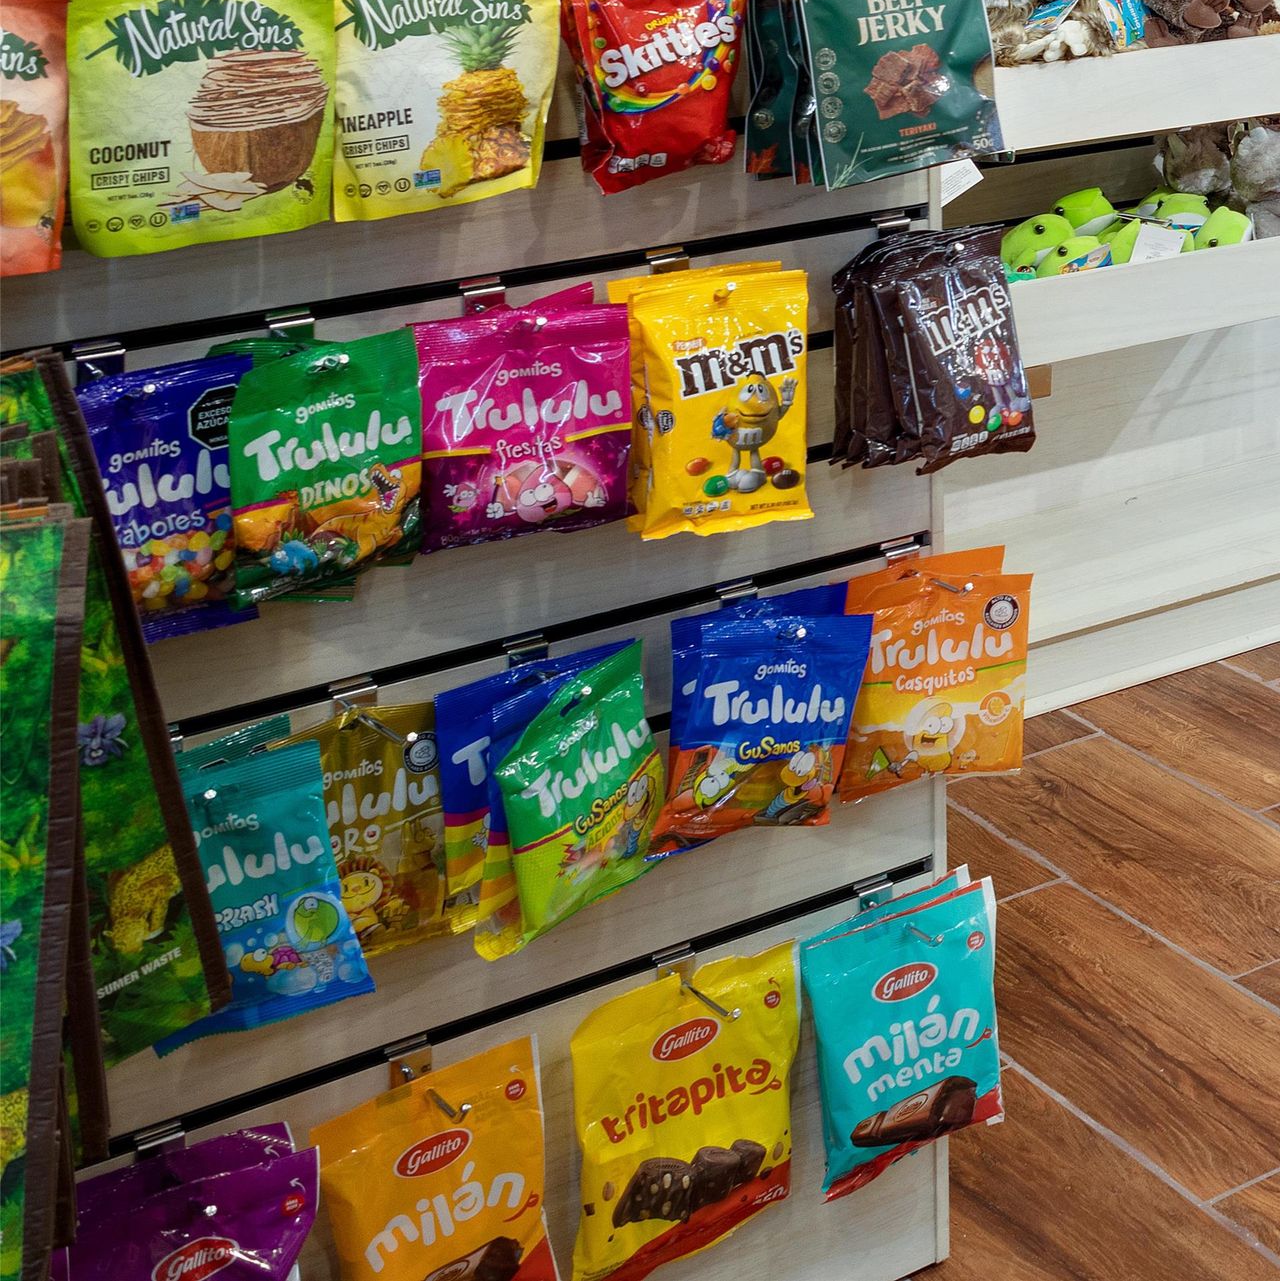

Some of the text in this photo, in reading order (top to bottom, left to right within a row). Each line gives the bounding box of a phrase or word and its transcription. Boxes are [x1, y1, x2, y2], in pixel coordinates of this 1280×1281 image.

[856, 5, 946, 46] JERKY
[122, 8, 239, 79] Natural
[600, 15, 736, 88] Skittles
[0, 50, 38, 75] ins
[342, 108, 413, 134] INEAPPLE
[898, 123, 937, 137] TERIYAKI
[89, 140, 171, 165] COCONUT
[344, 138, 406, 155] CRISPY CHIPS
[96, 170, 165, 186] CRISPY CHIPS
[496, 359, 563, 386] gomitas
[674, 329, 804, 400] m&m's
[198, 406, 232, 420] EXCESO
[294, 391, 356, 424] gomitas
[436, 382, 622, 431] Trululu
[109, 437, 181, 473] gomitas
[244, 410, 412, 481] Trululu
[496, 433, 562, 465] fresitas
[301, 472, 372, 509] DINOS
[911, 608, 965, 637] gomitas
[869, 623, 1013, 675] Trululu
[754, 658, 807, 681] gomitas
[894, 665, 975, 696] Casquitos
[704, 681, 846, 727] Trululu
[739, 735, 801, 762] GuSanos
[521, 718, 650, 818] Trululu
[135, 946, 182, 978] WASTE
[880, 968, 931, 1001] Gallito
[657, 1025, 713, 1060] Gallito
[842, 994, 981, 1086] milán
[866, 1046, 963, 1103] menta
[599, 1056, 774, 1144] tritapita
[405, 1133, 462, 1175] Gallito
[364, 1161, 526, 1274] milán
[166, 1246, 226, 1281] Gallito
